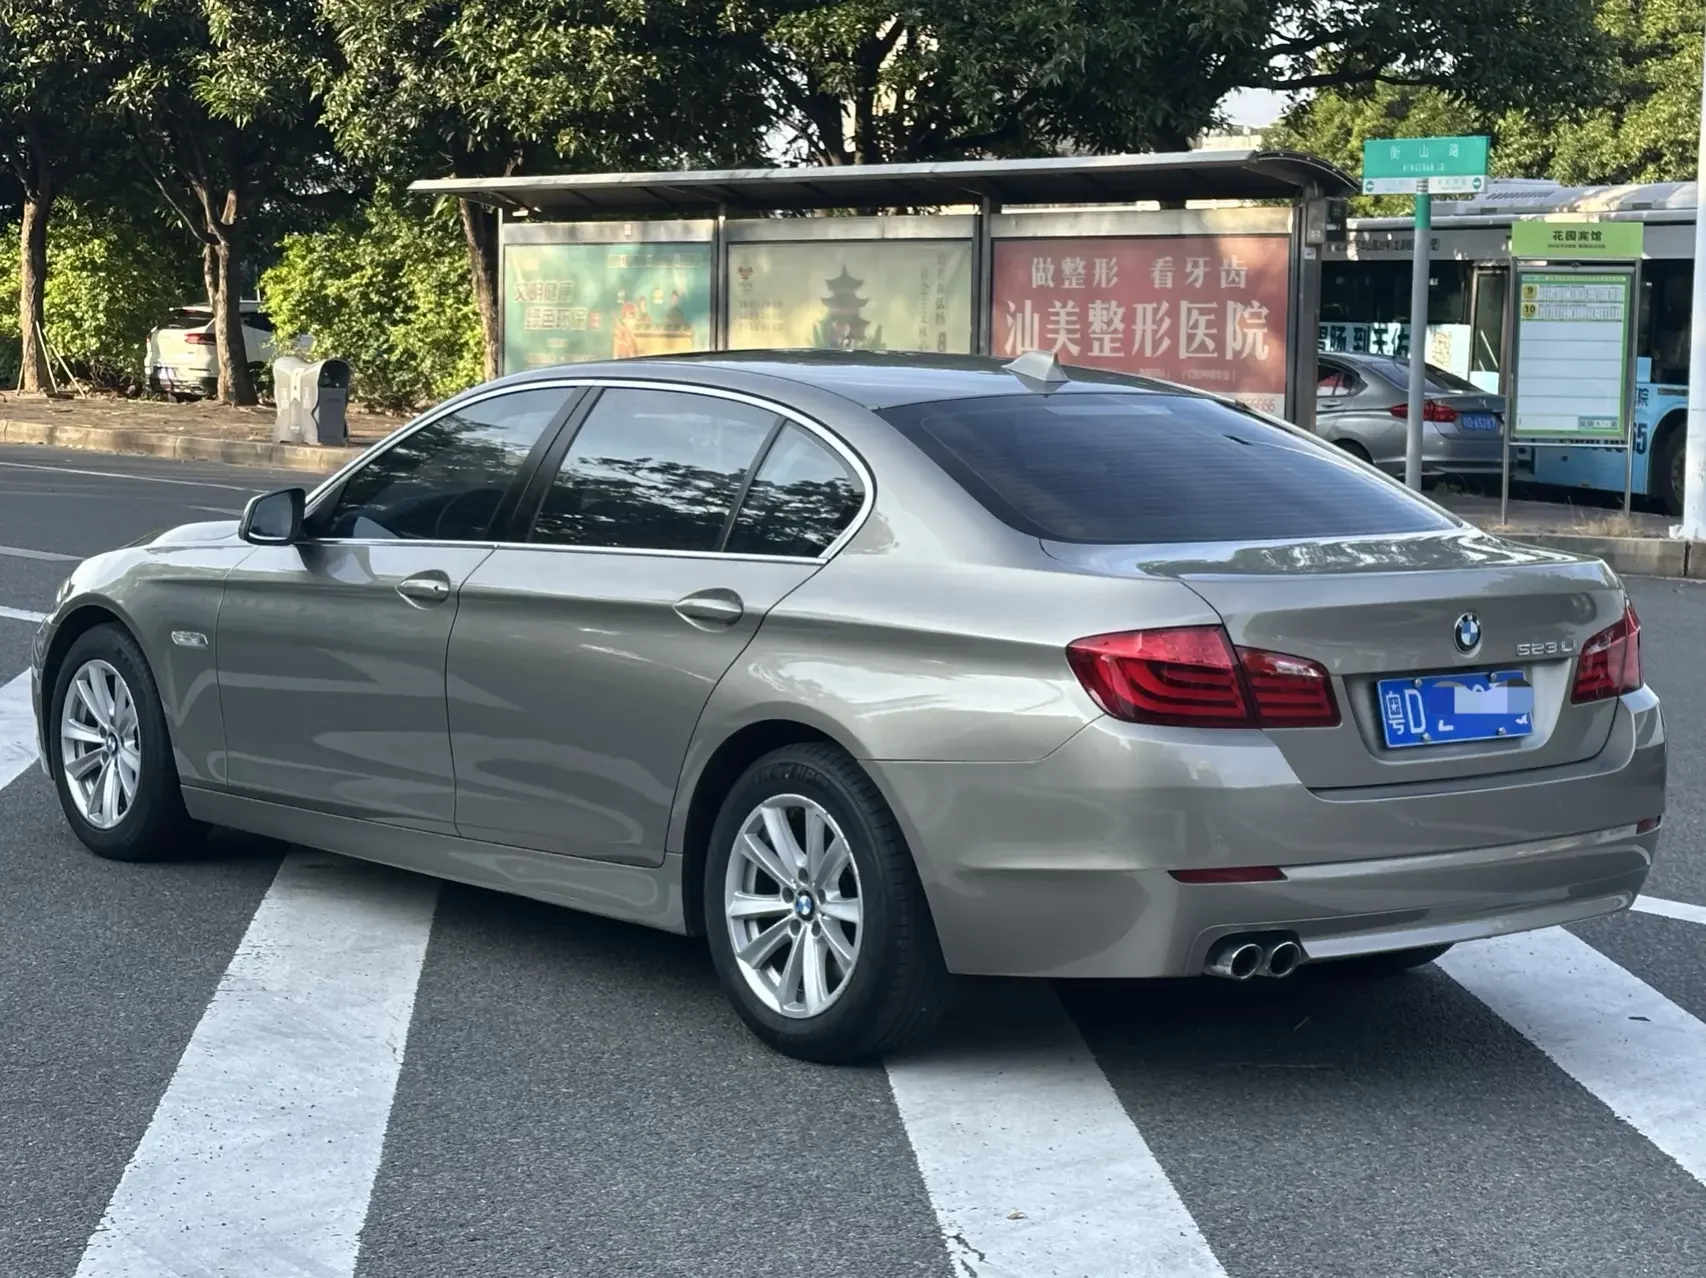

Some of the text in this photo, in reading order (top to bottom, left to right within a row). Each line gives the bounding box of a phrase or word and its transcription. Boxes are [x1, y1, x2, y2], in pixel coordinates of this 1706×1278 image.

[1552, 230, 1602, 241] 花园宾馆
[1031, 255, 1248, 289] 做整形 看牙齿
[1524, 304, 1536, 314] 10
[1004, 299, 1270, 360] 汕美整形医院
